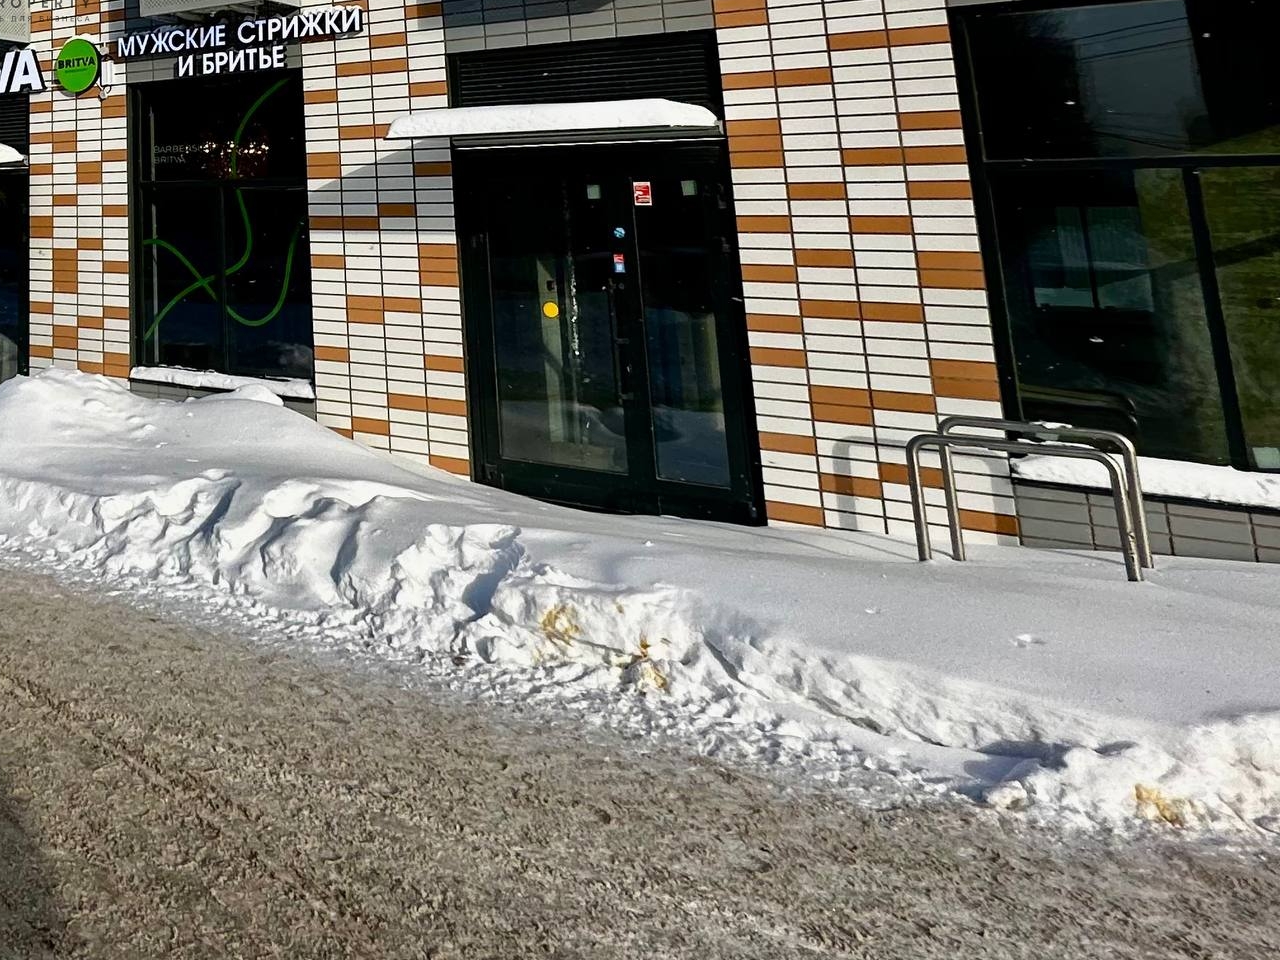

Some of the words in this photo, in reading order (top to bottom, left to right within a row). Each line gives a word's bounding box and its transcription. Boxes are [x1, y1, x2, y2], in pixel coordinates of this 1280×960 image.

[117, 24, 226, 58] МУЖСКИЕ
[237, 7, 361, 44] СТРИЖКИ
[58, 56, 96, 70] BRITVA
[178, 54, 194, 77] И
[202, 45, 285, 76] БРИТЬЕ
